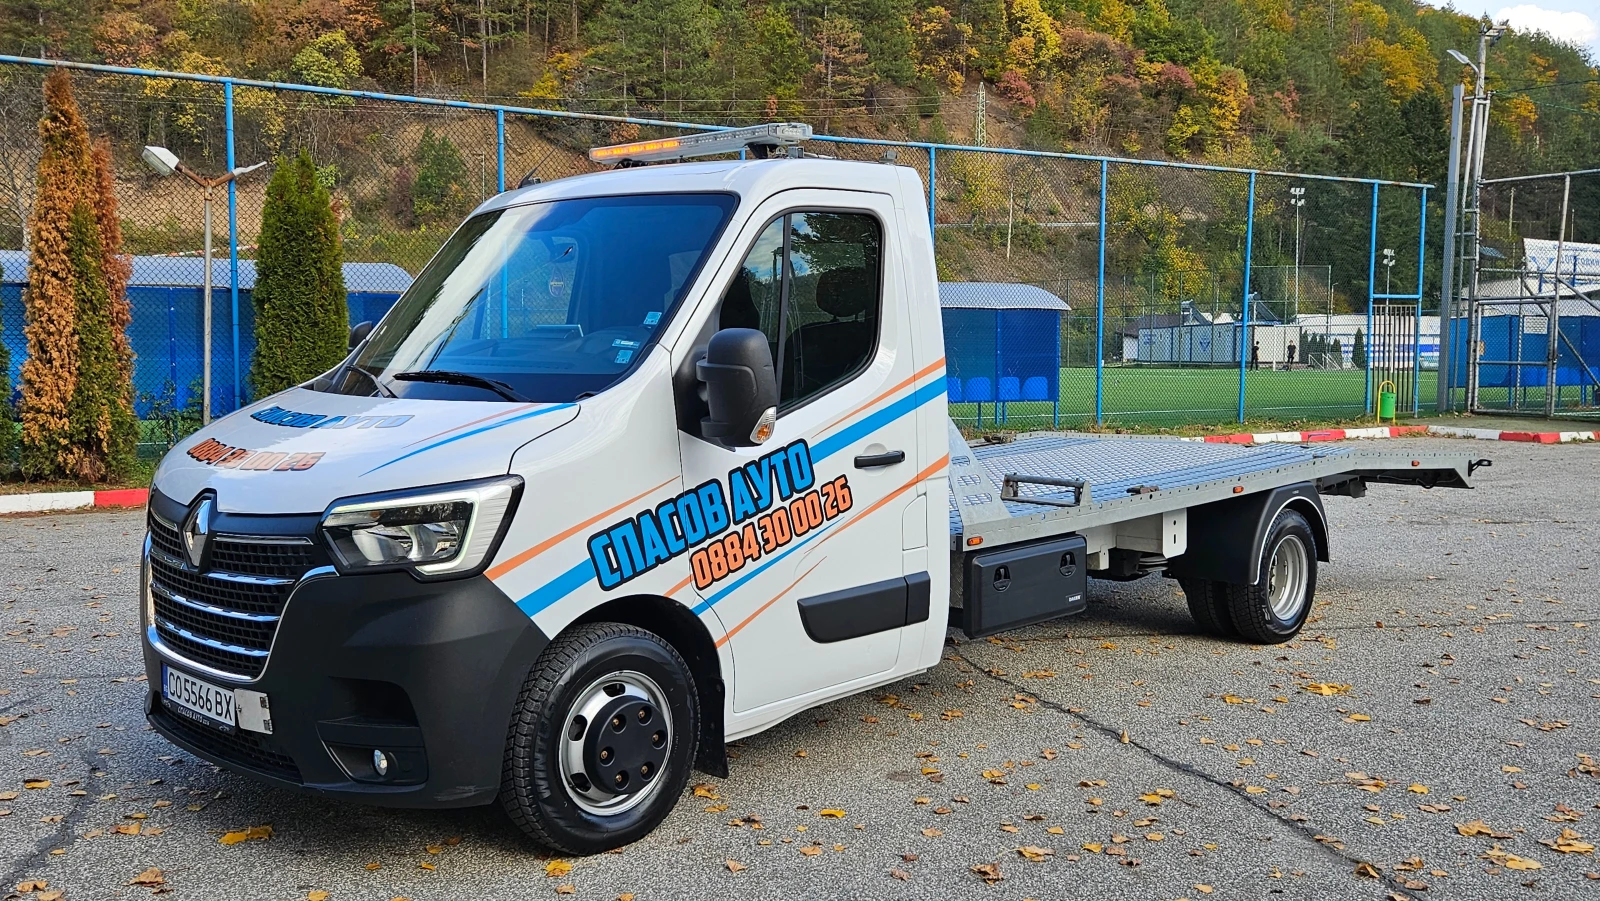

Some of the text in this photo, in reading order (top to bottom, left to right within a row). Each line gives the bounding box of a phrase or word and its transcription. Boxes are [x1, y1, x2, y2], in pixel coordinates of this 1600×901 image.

[186, 437, 327, 472] 0884 30 00 26
[310, 414, 416, 430] АУТО
[587, 438, 816, 591] СПАСОВ АУТО
[690, 474, 854, 591] 0884 30 00 26
